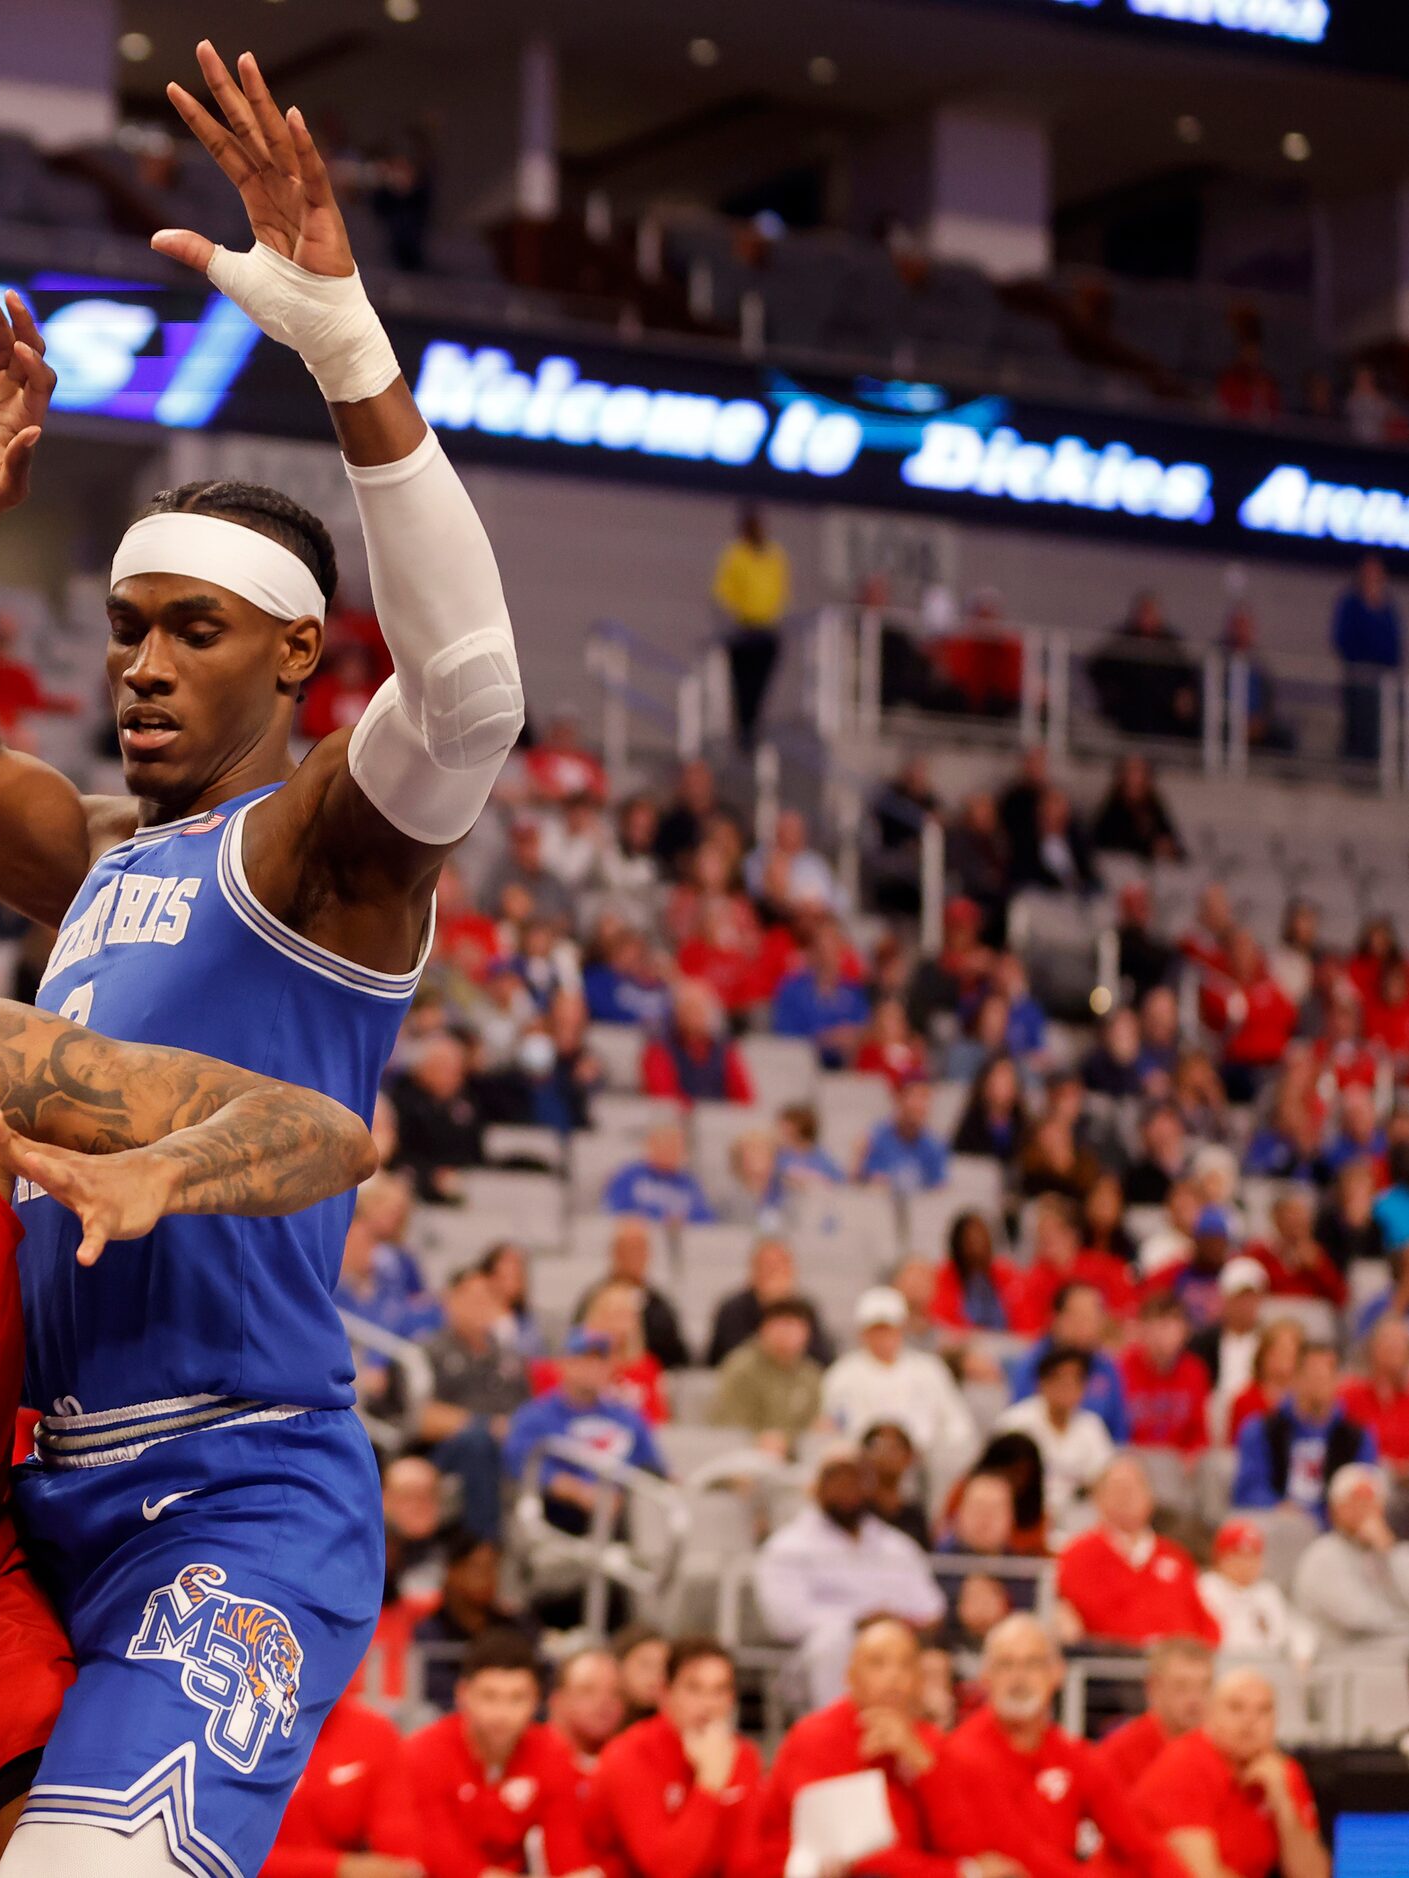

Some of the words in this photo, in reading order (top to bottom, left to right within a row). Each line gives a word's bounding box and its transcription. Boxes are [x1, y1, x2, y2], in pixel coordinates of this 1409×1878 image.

[412, 339, 769, 466] Welcome
[767, 399, 862, 477] to
[901, 420, 1212, 521] Dickies
[1237, 463, 1409, 551] Aren
[125, 1584, 276, 1775] MSU
